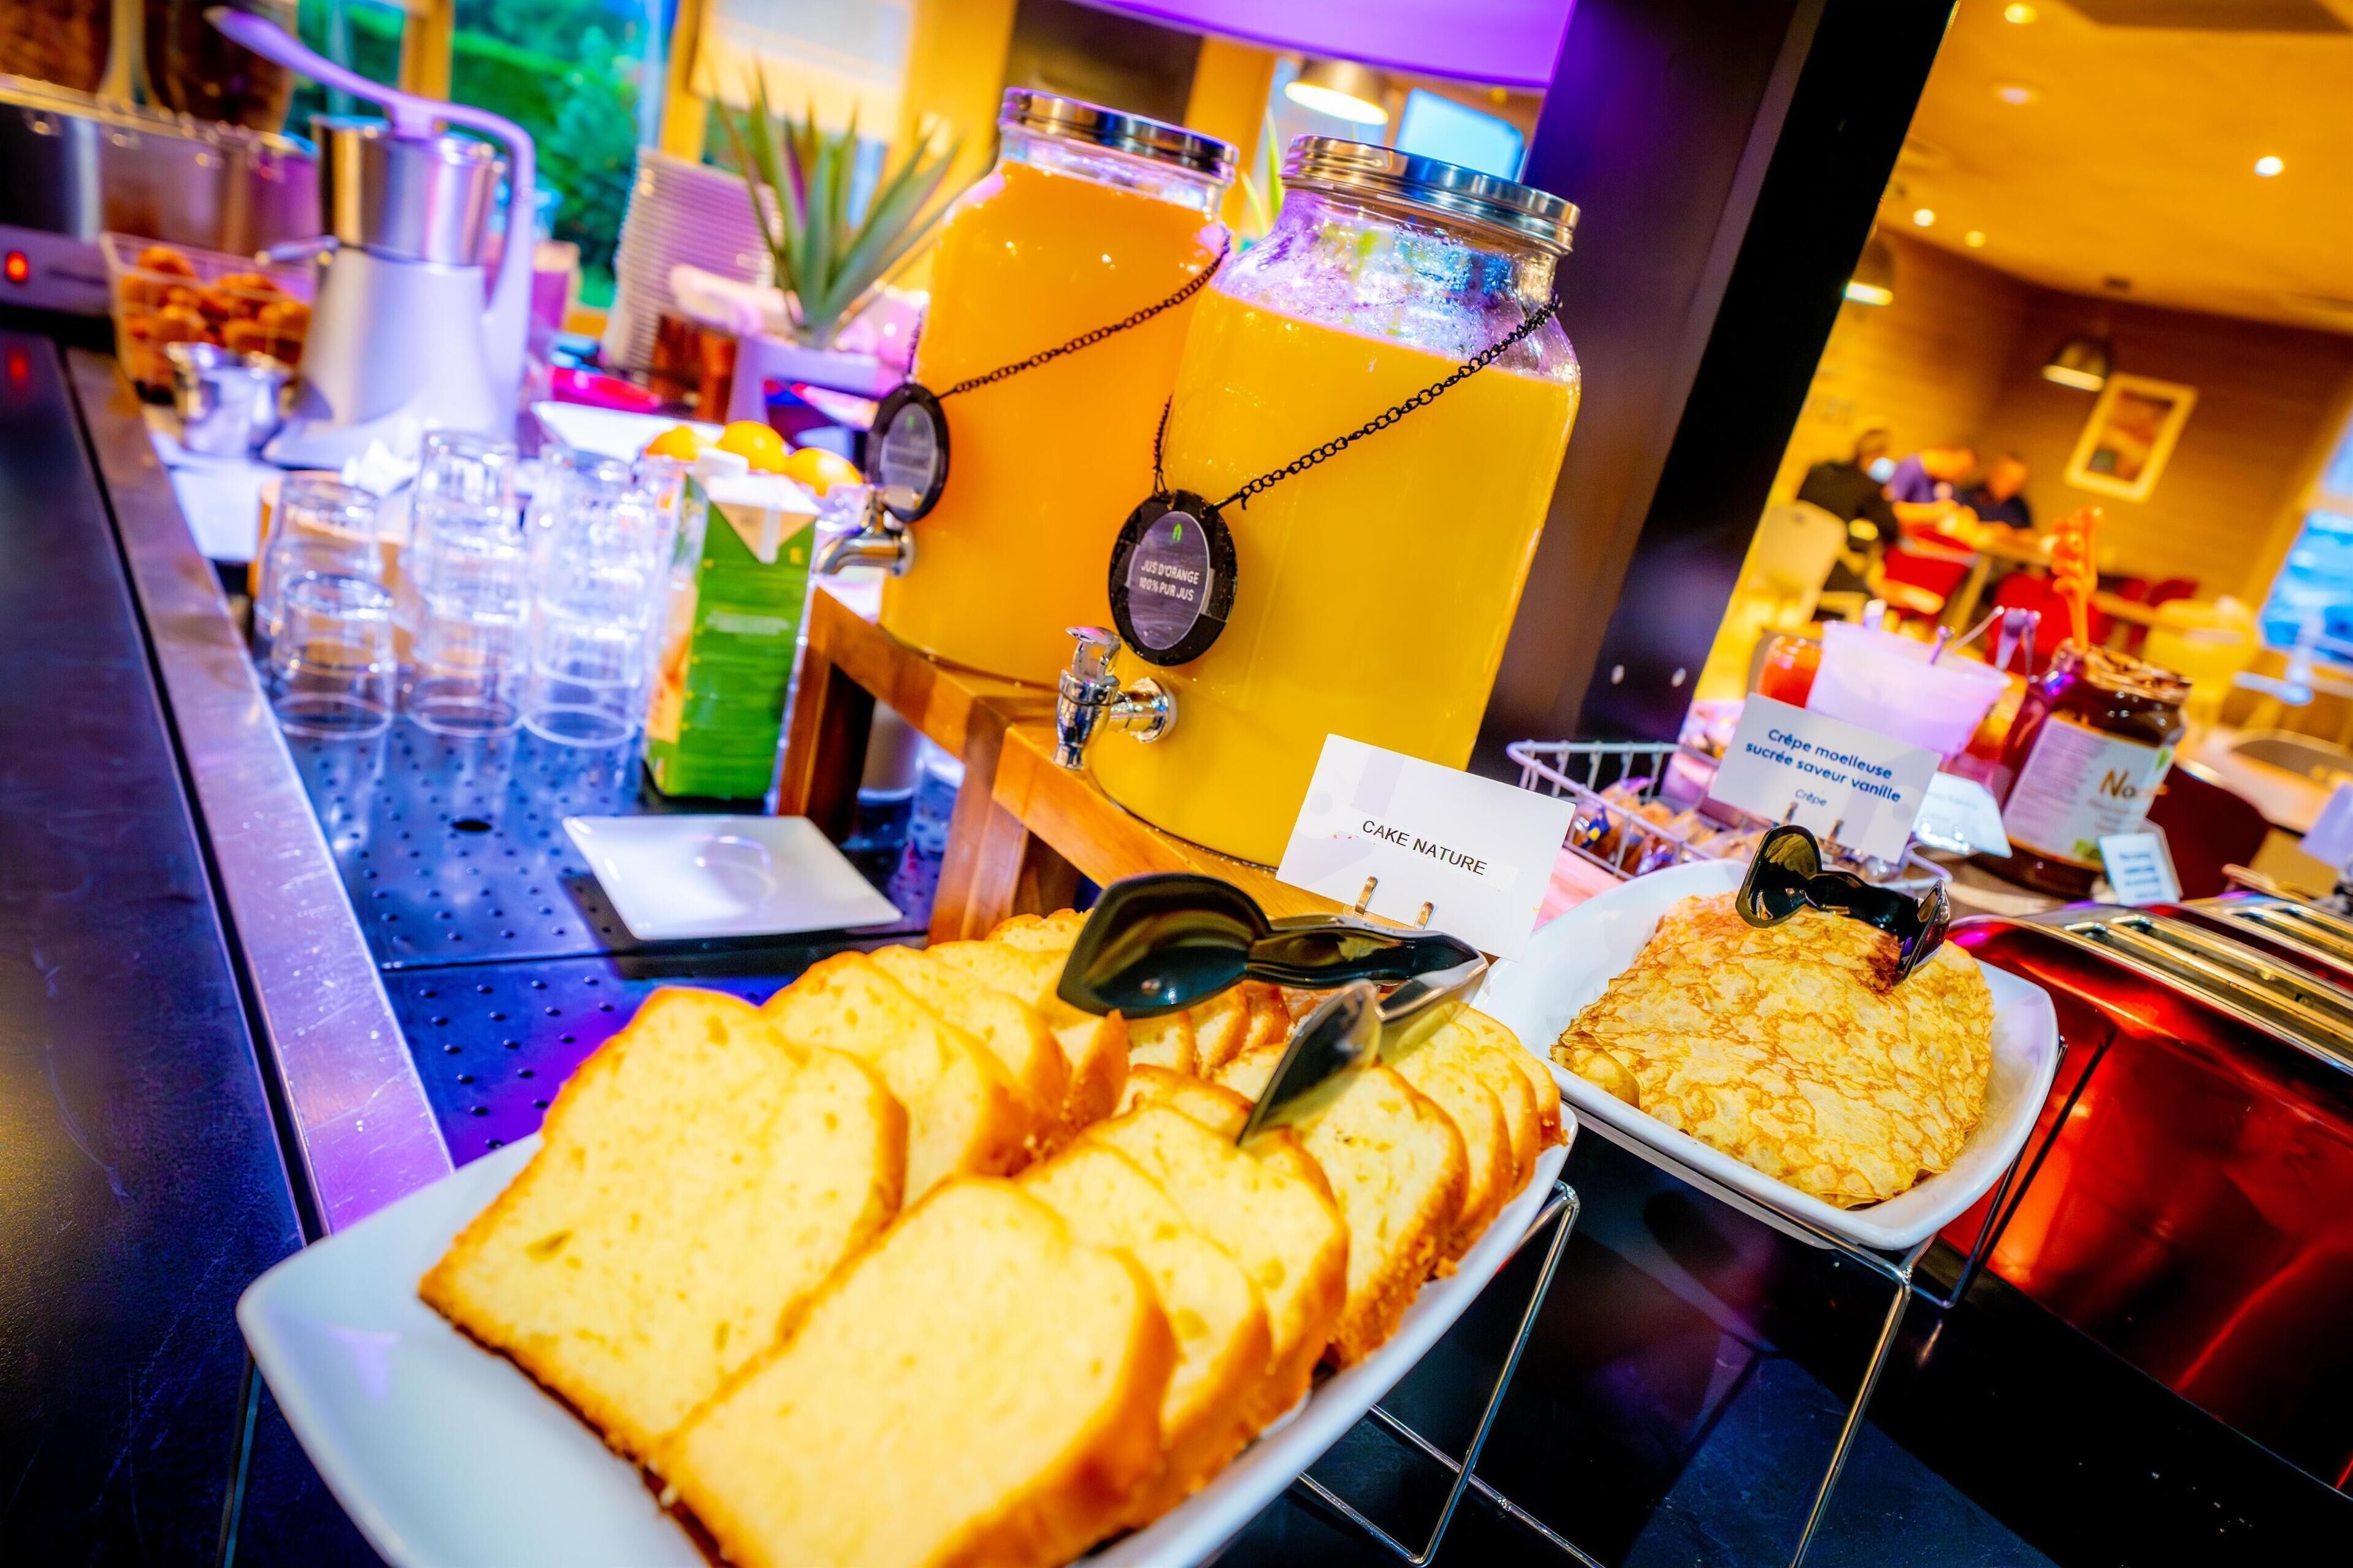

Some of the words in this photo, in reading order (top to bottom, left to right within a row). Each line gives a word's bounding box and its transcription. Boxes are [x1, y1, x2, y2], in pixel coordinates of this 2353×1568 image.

[1139, 577, 1158, 592] 100%
[1158, 582, 1176, 597] PUR
[1176, 586, 1195, 602] JUS
[1141, 560, 1157, 574] JUS
[1158, 564, 1200, 584] D'ORANGE
[1746, 741, 1793, 767] sucrée
[1797, 760, 1848, 784] saveur
[1852, 778, 1901, 803] vanille
[1769, 729, 1812, 753] Crêpe
[1815, 746, 1892, 779] moelleuse
[1795, 788, 1827, 807] Crêpe
[1363, 820, 1410, 847] CAKE
[1412, 838, 1488, 876] NATURE
